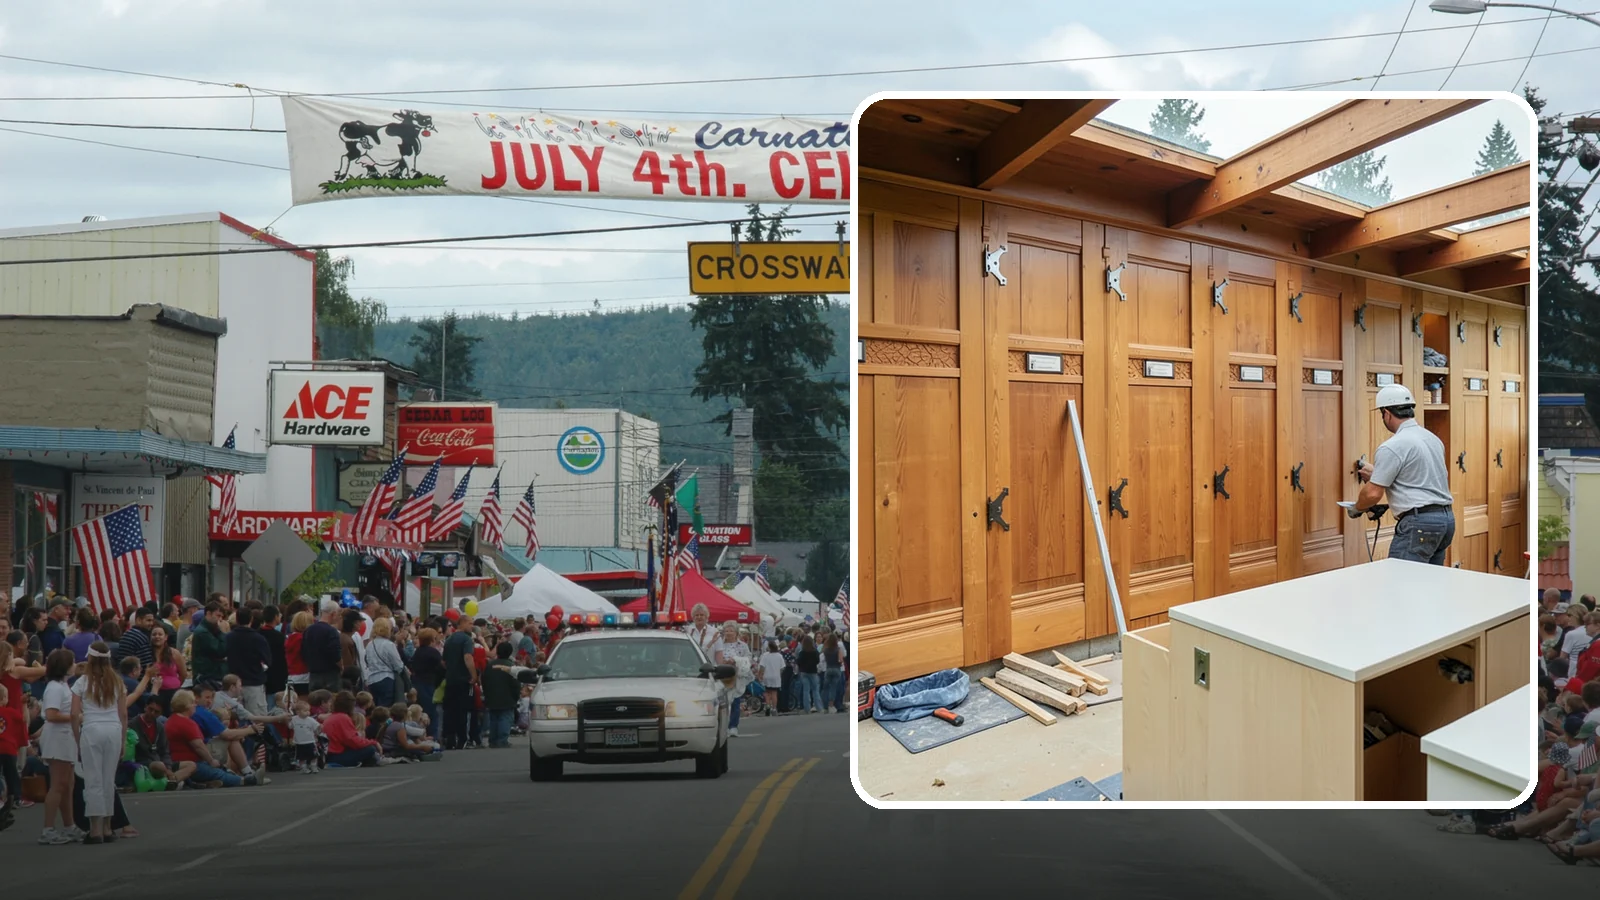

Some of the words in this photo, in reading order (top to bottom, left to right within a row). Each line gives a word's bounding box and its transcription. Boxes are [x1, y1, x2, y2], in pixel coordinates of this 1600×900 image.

[481, 141, 605, 192] JULY
[632, 150, 746, 197] 4th.
[697, 254, 850, 280] CROSSWA
[283, 380, 373, 420] ACE
[405, 409, 452, 421] CEDAR
[283, 421, 371, 436] Hardware
[416, 428, 476, 447] Coca-Cola
[83, 486, 94, 494] St.
[95, 485, 124, 495] Vincent
[126, 486, 135, 495] de
[138, 486, 155, 495] Paul
[81, 503, 153, 522] THT
[212, 516, 330, 535] HARDARE
[688, 526, 741, 535] CRNATION
[699, 535, 730, 543] GLASS
